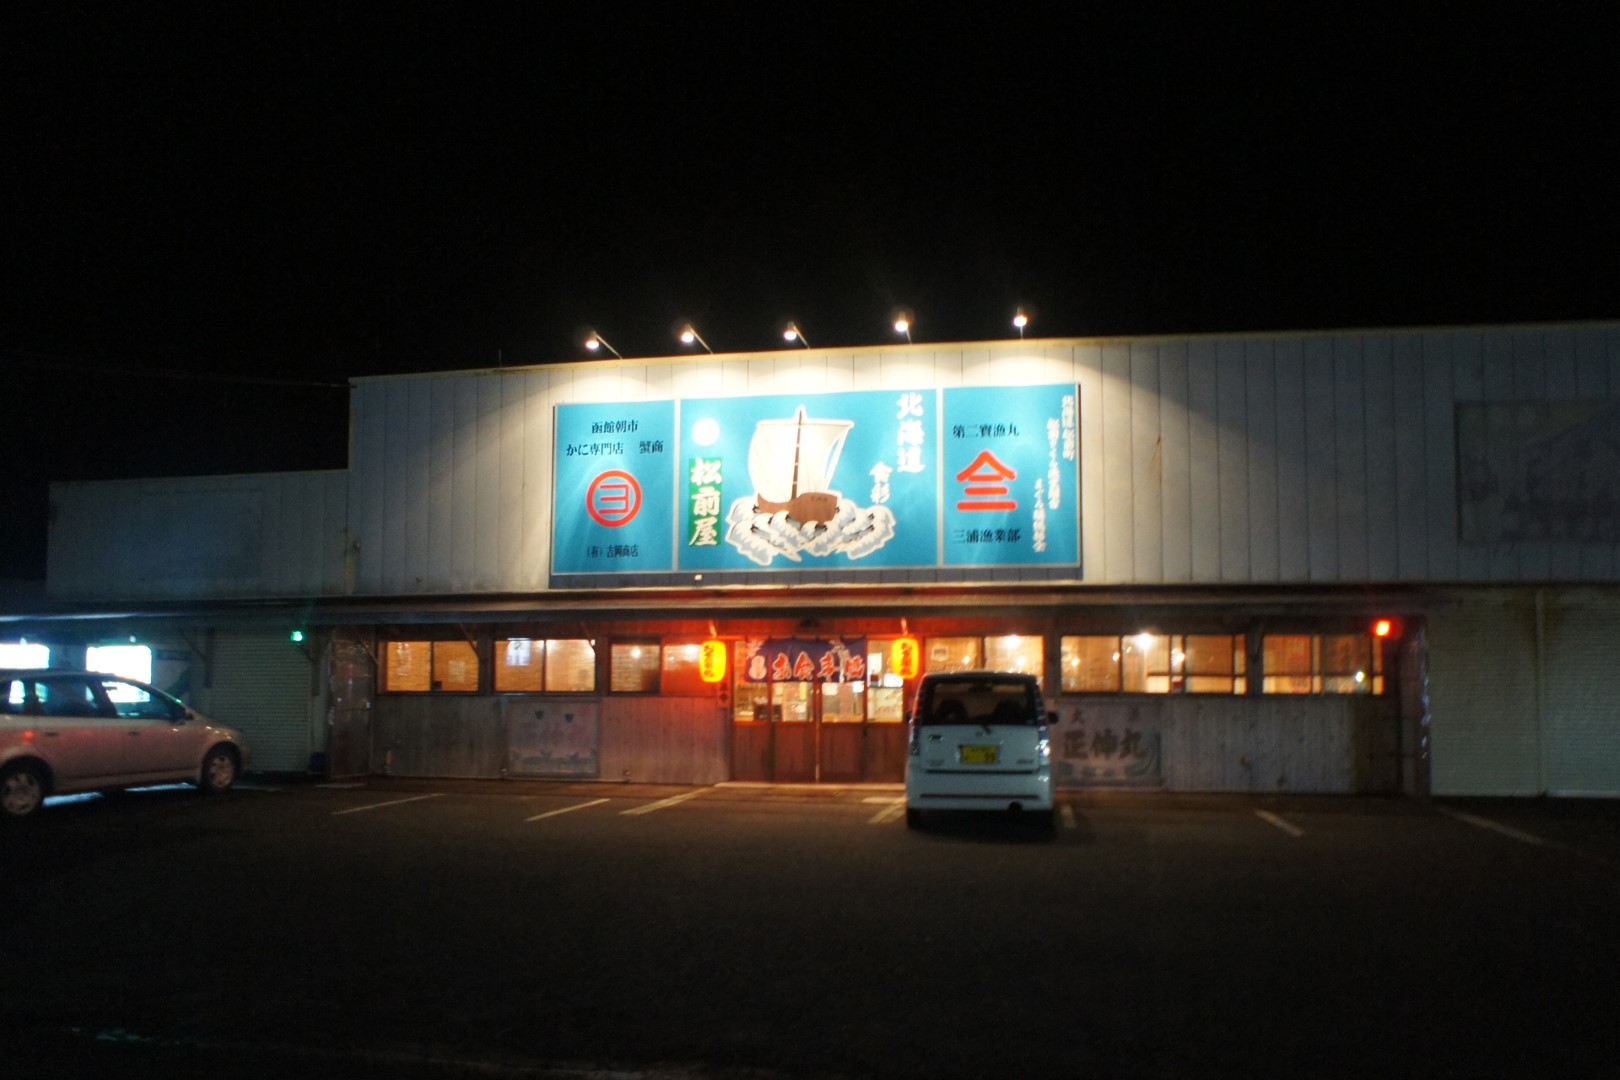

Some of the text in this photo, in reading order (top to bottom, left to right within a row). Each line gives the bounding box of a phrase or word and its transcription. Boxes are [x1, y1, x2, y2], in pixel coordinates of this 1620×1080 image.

[592, 420, 638, 434] 函館朝市
[897, 393, 925, 472] 北海道
[566, 442, 624, 457] かに専門店
[689, 458, 723, 546] 松前屋
[952, 528, 1021, 544] 三浦漁業部
